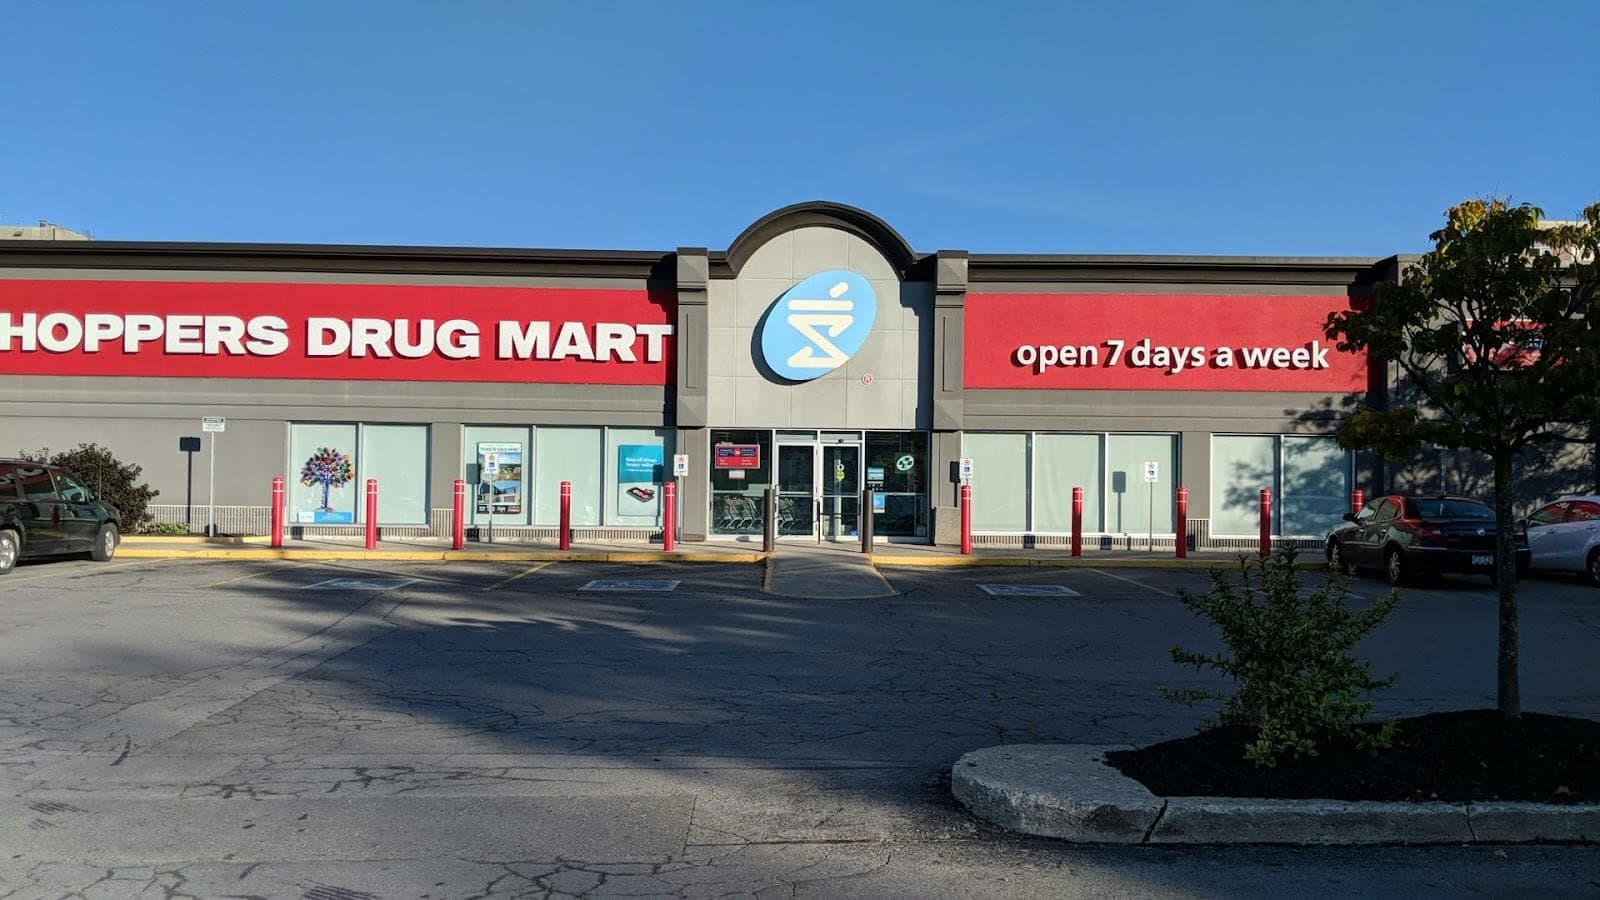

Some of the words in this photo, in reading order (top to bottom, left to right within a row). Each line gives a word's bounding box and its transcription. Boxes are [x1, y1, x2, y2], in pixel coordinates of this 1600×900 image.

[0, 313, 289, 356] HOPPERS
[308, 318, 480, 359] DRUG
[499, 321, 673, 362] MART
[1016, 346, 1098, 373] open
[1108, 340, 1125, 366] 7
[1132, 339, 1206, 374] days
[1215, 347, 1233, 367] a
[1243, 341, 1330, 368] week
